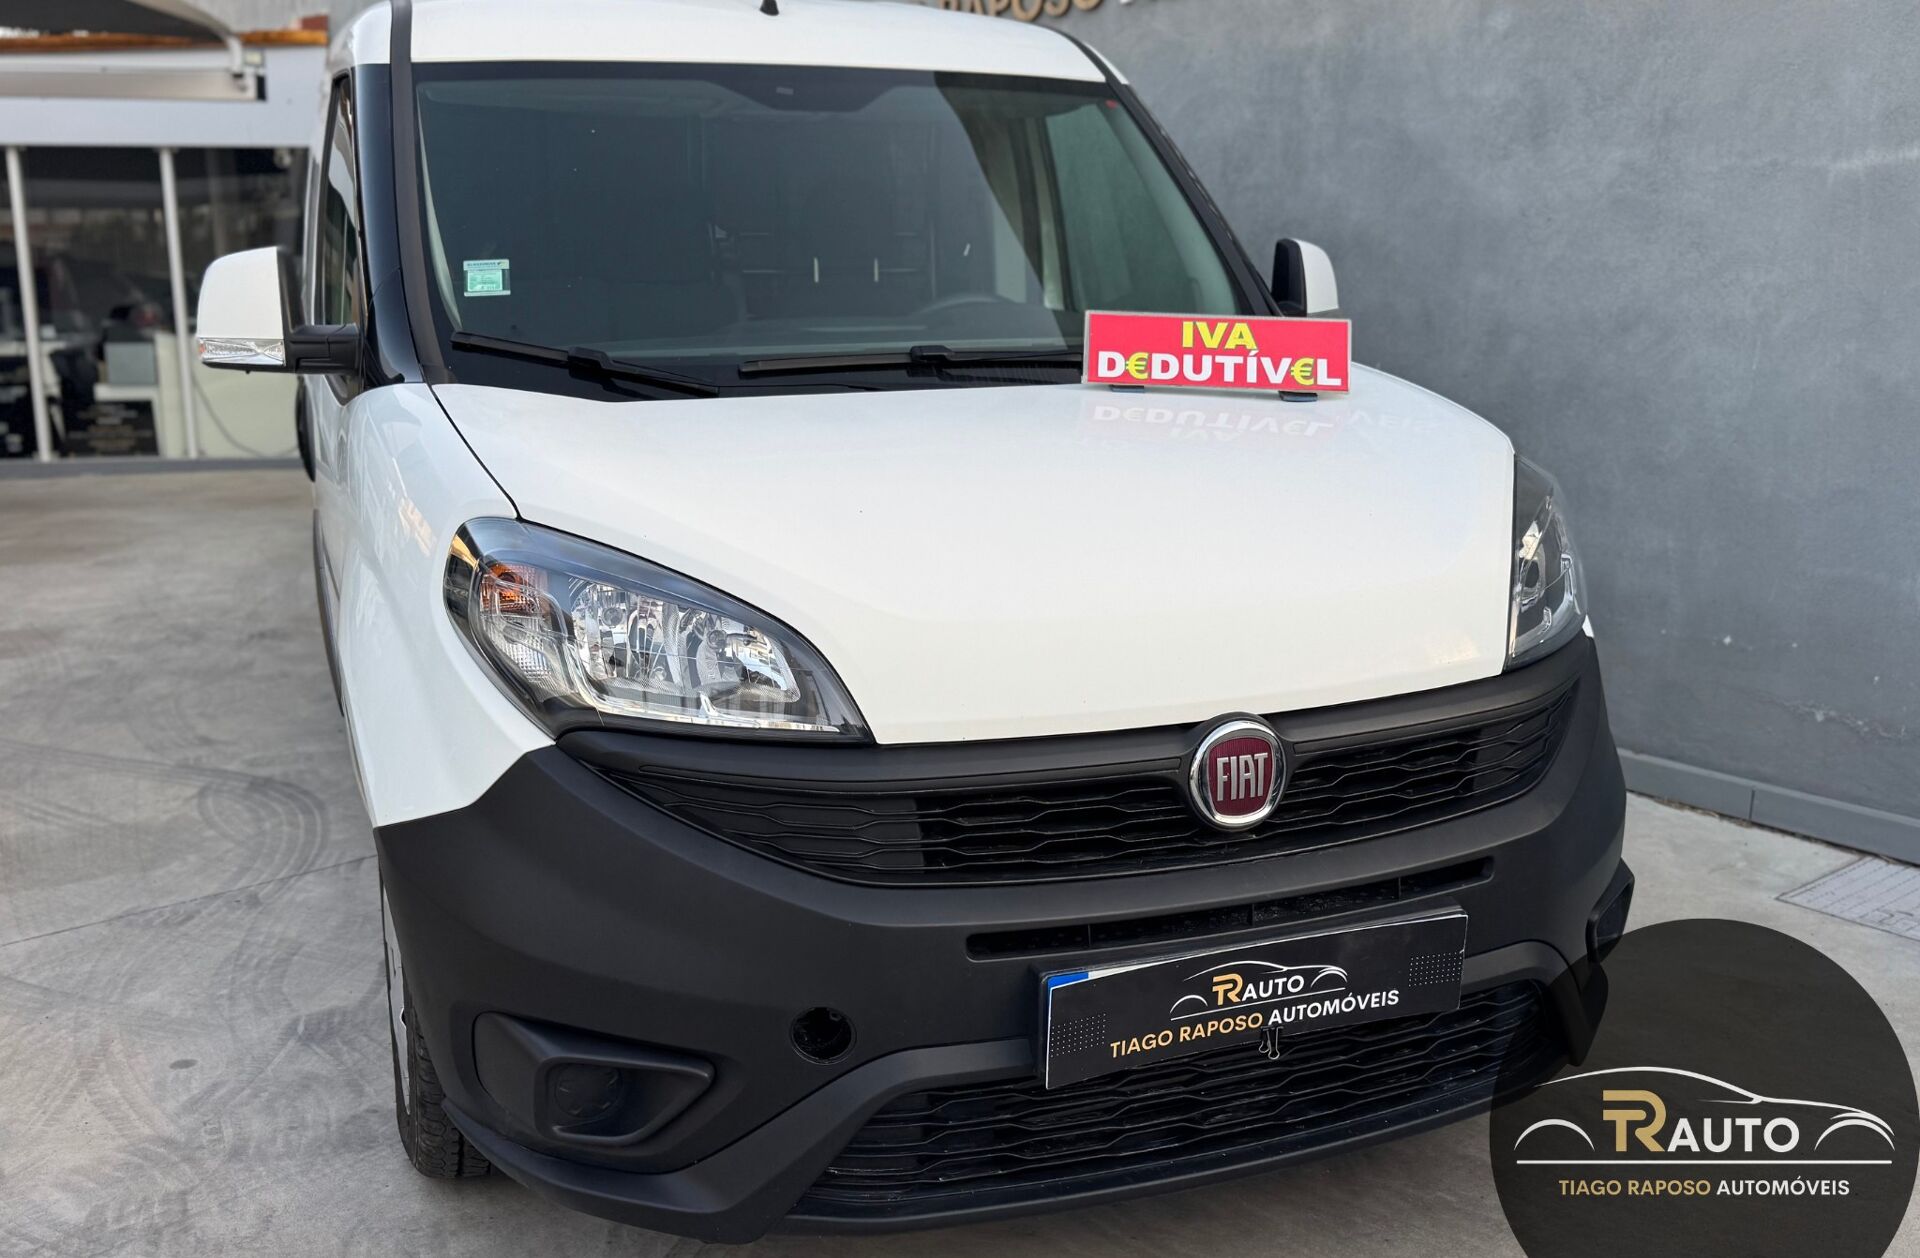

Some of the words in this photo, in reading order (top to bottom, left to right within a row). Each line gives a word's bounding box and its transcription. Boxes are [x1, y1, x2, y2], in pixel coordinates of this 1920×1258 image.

[1182, 320, 1258, 350] IVA
[1216, 752, 1268, 802] FIAT
[1110, 1030, 1173, 1058] TIAGO
[1179, 1012, 1263, 1042] RAPOSO
[1268, 990, 1400, 1025] AUTOMÓVEIS
